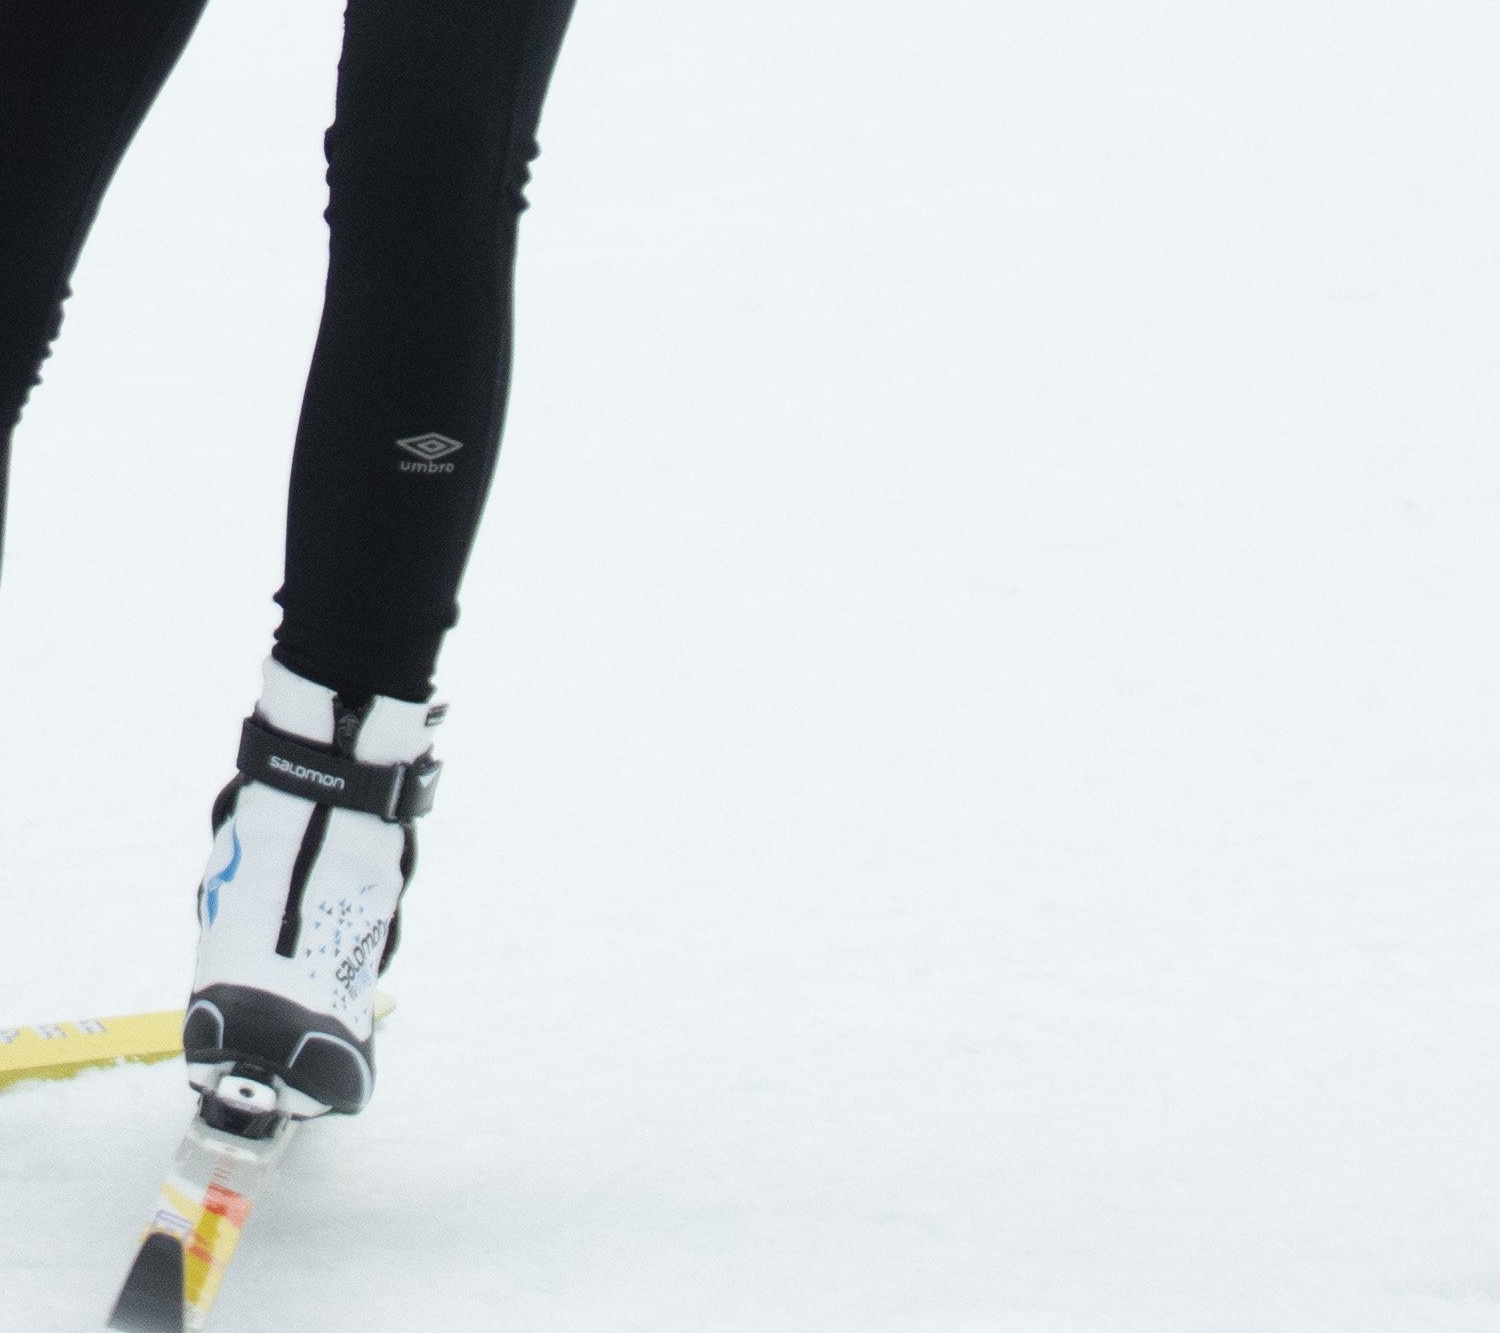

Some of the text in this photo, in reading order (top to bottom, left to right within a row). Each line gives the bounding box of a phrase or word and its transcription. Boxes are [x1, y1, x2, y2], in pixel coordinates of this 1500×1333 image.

[399, 459, 455, 474] umbro
[269, 754, 346, 790] salomon
[335, 917, 388, 993] salomon
